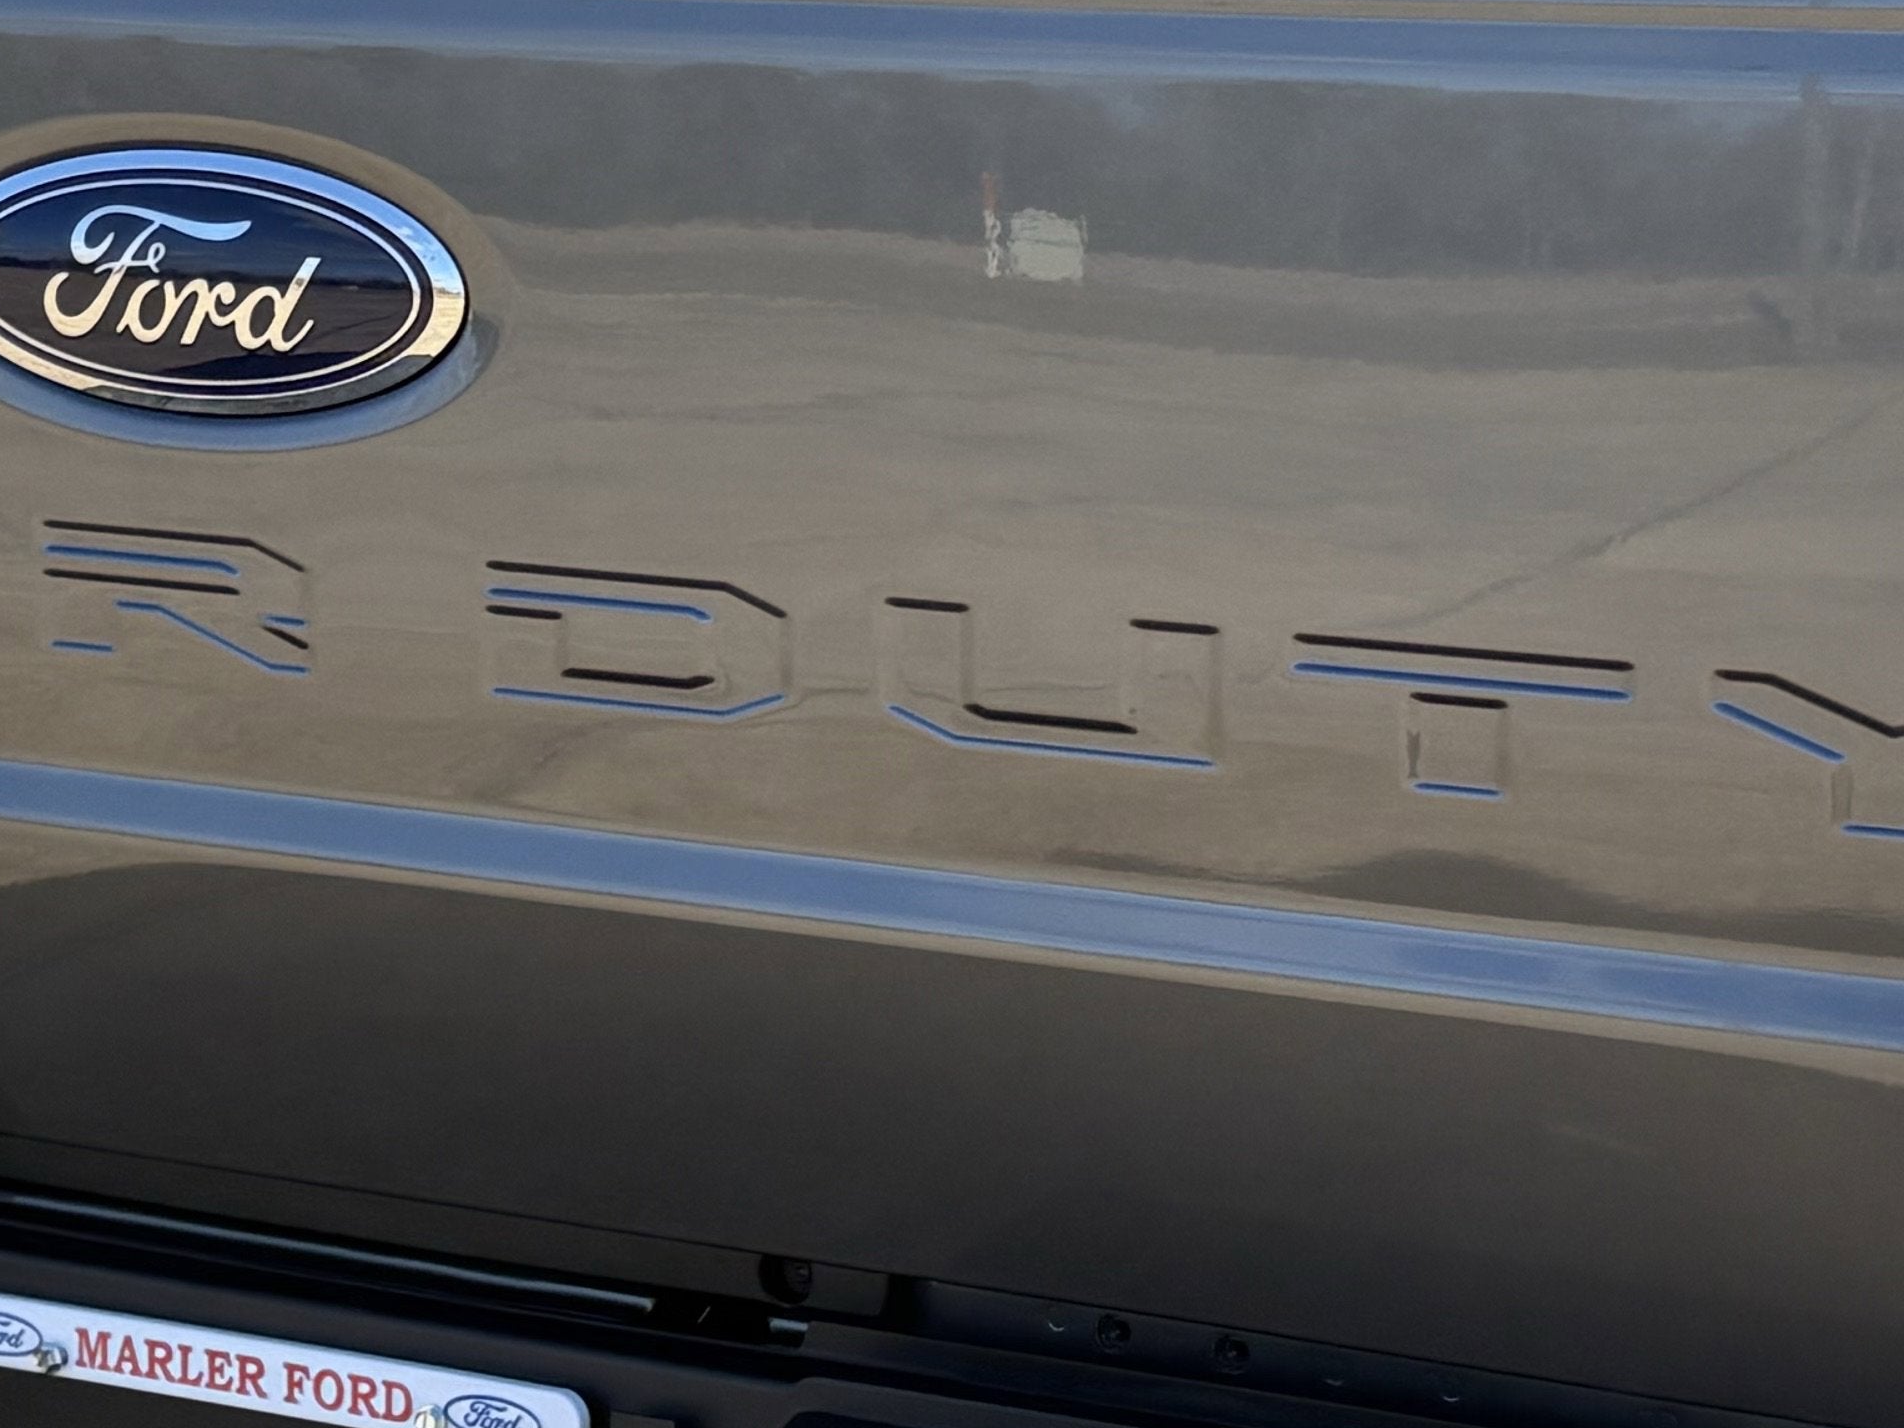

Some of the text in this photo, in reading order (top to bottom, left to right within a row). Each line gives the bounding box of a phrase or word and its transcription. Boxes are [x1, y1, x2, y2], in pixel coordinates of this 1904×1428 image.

[42, 204, 321, 353] Ford
[74, 1327, 414, 1424] MARLER FORD
